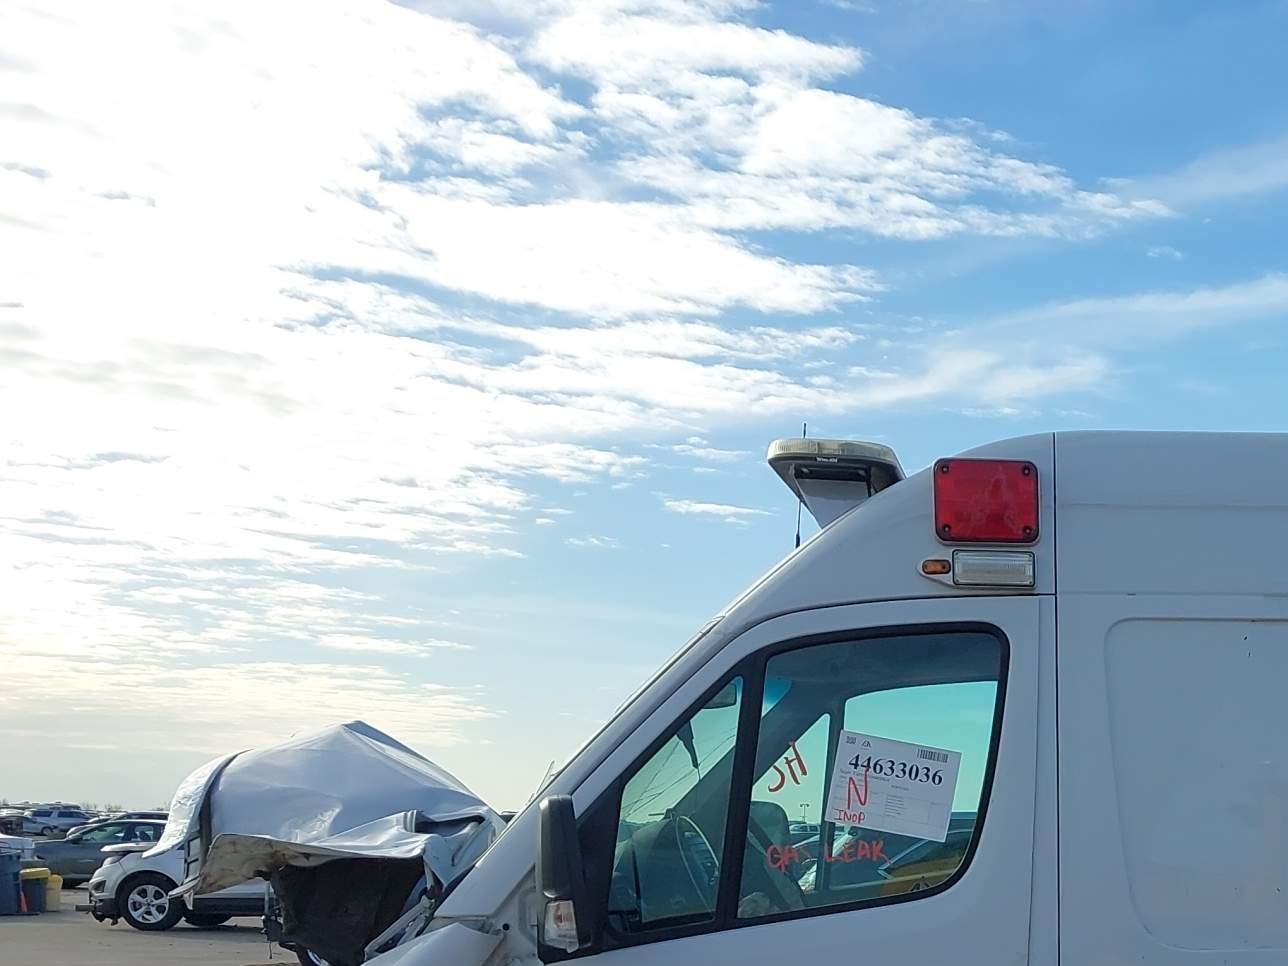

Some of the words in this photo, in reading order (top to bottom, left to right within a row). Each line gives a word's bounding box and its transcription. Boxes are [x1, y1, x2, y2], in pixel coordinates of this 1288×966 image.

[848, 753, 945, 786] 44633036
[847, 768, 869, 810] N
[833, 808, 866, 825] INOP
[824, 839, 891, 865] LEAK
